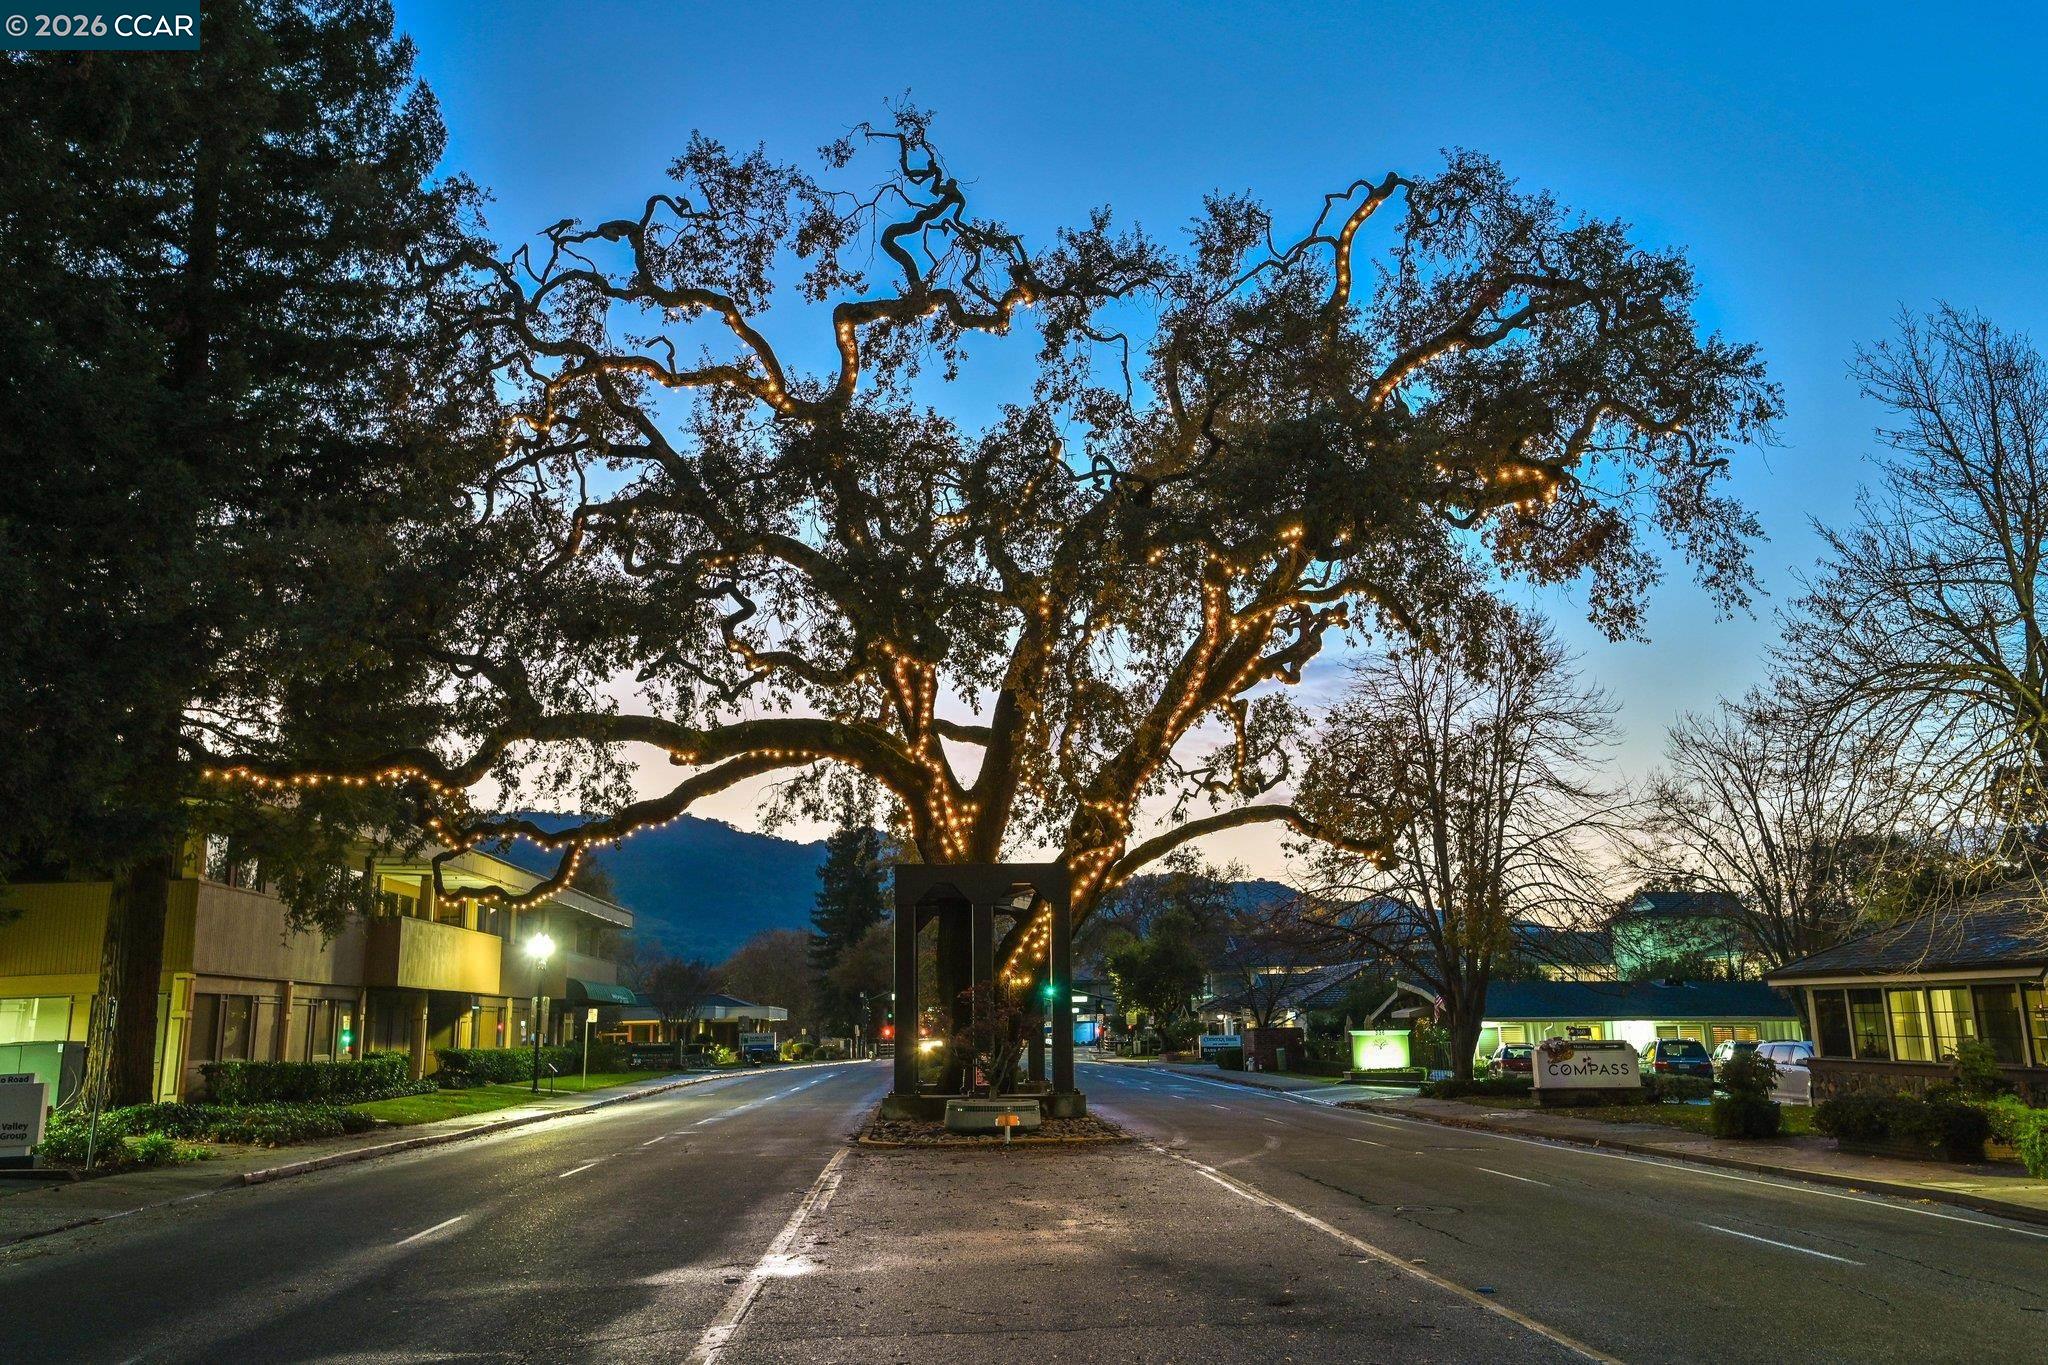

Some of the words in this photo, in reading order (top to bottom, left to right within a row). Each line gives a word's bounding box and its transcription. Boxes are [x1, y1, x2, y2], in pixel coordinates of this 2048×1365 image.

[1548, 1063, 1630, 1076] COMPASS
[8, 1075, 29, 1083] Road
[2, 1122, 28, 1131] Valley
[0, 1132, 28, 1141] Group
